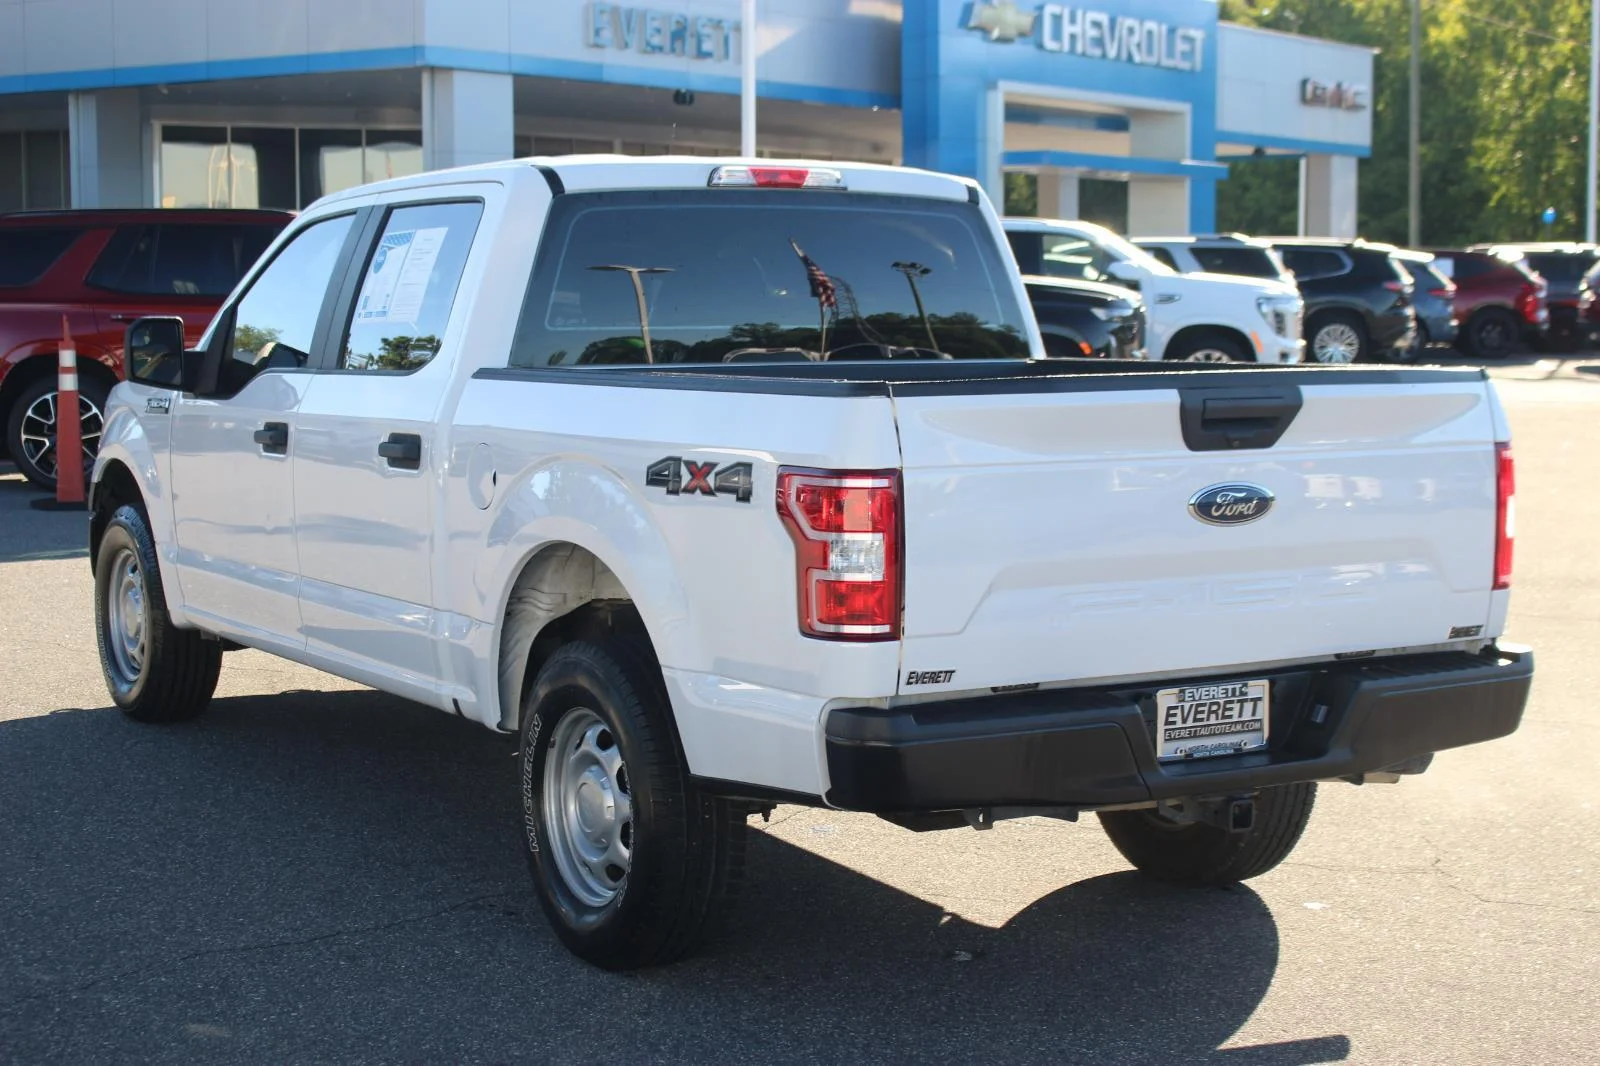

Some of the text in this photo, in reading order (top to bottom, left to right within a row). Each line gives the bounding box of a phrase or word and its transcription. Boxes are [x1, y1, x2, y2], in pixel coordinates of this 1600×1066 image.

[1041, 3, 1206, 72] CHEVROLET
[1211, 491, 1259, 517] Ford
[905, 669, 956, 686] EVERETT
[1184, 684, 1243, 702] EVERETT
[1164, 697, 1263, 726] EVERETT
[1165, 721, 1261, 740] EVERETTAUTOTEAM.COM
[521, 713, 544, 853] MICHELIN
